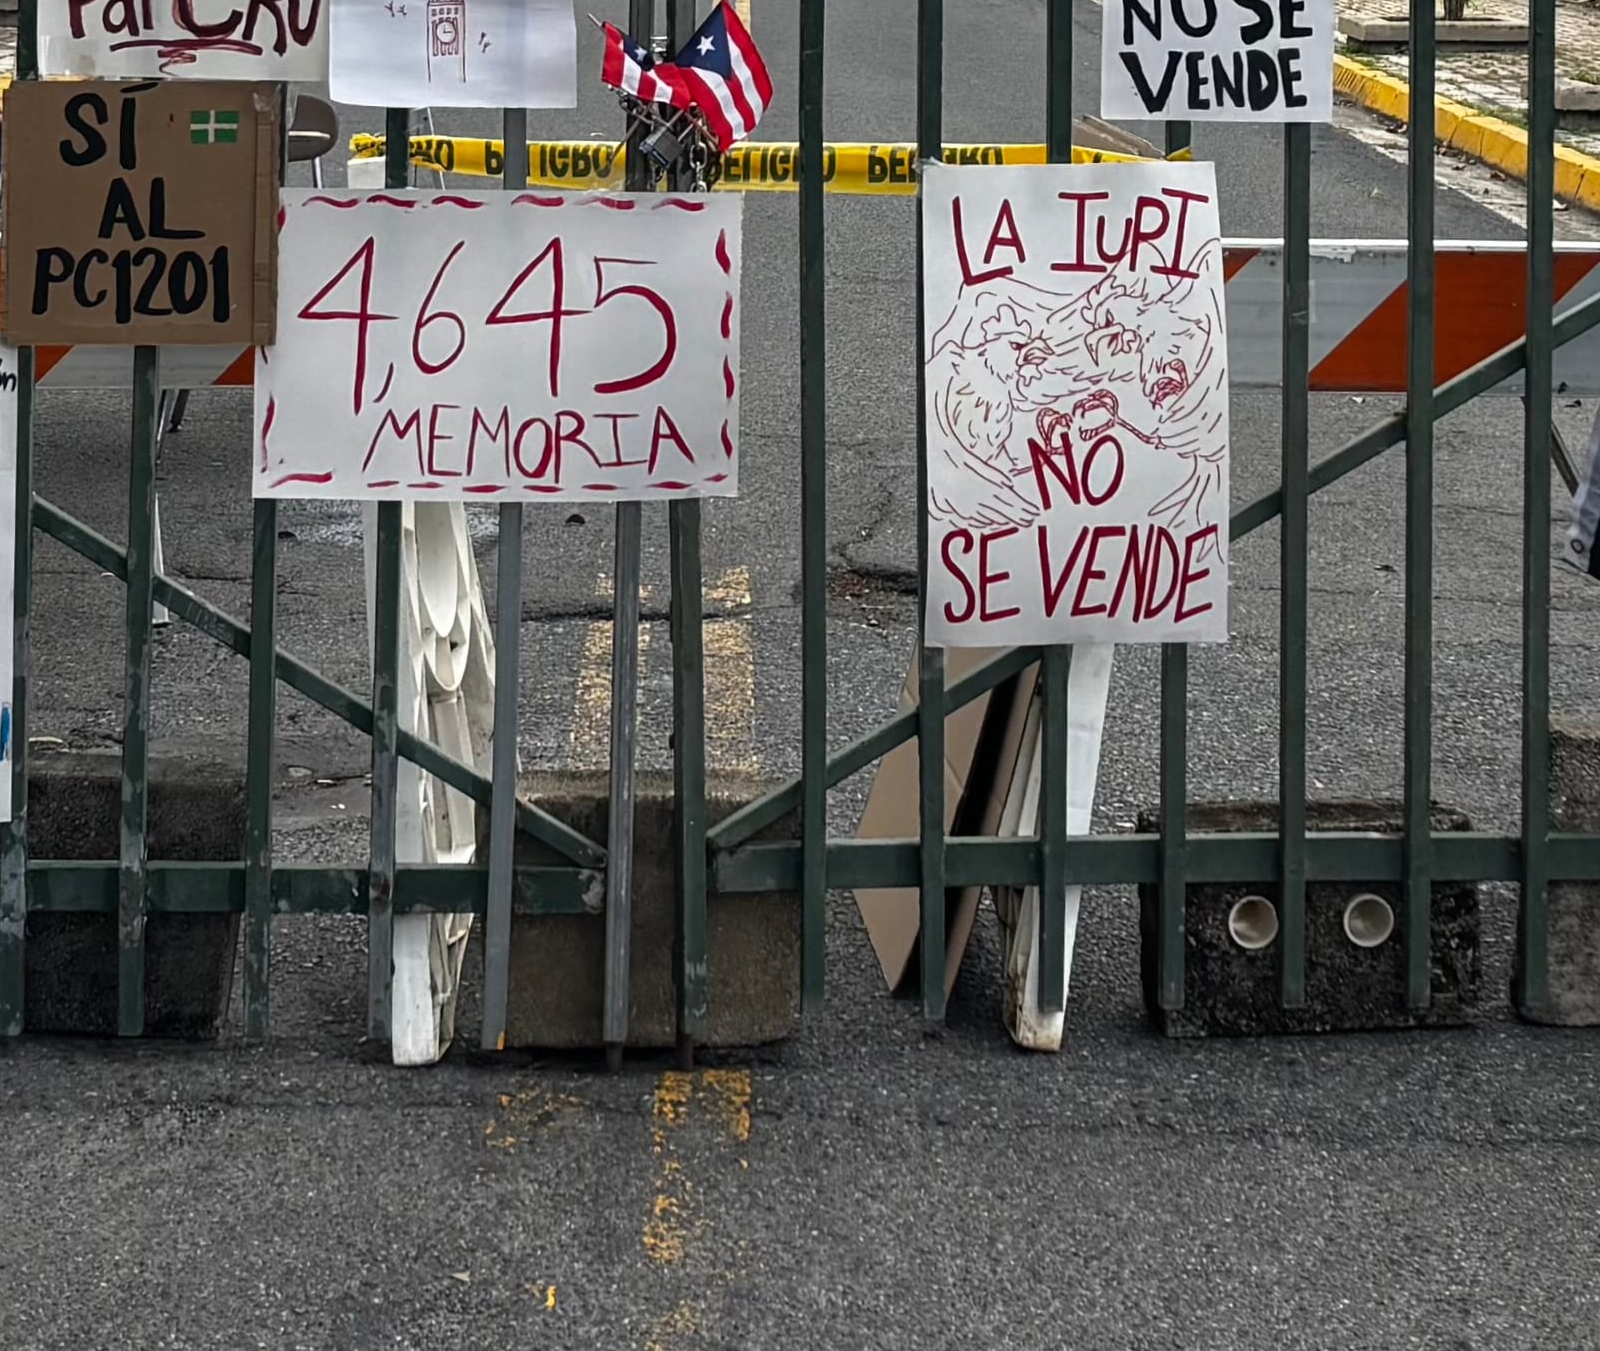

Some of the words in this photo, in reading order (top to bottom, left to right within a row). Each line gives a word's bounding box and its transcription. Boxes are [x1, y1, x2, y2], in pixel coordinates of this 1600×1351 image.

[1118, 48, 1308, 114] VENDE
[59, 82, 159, 170] SÍ
[98, 177, 206, 241] AL
[952, 196, 1026, 286] LA
[31, 245, 230, 324] PC1201
[298, 236, 677, 416] 4,645
[362, 403, 695, 483] MEMORIA
[1027, 430, 1124, 511] NO
[941, 525, 1021, 624] SE
[1038, 523, 1217, 624] VENDE
